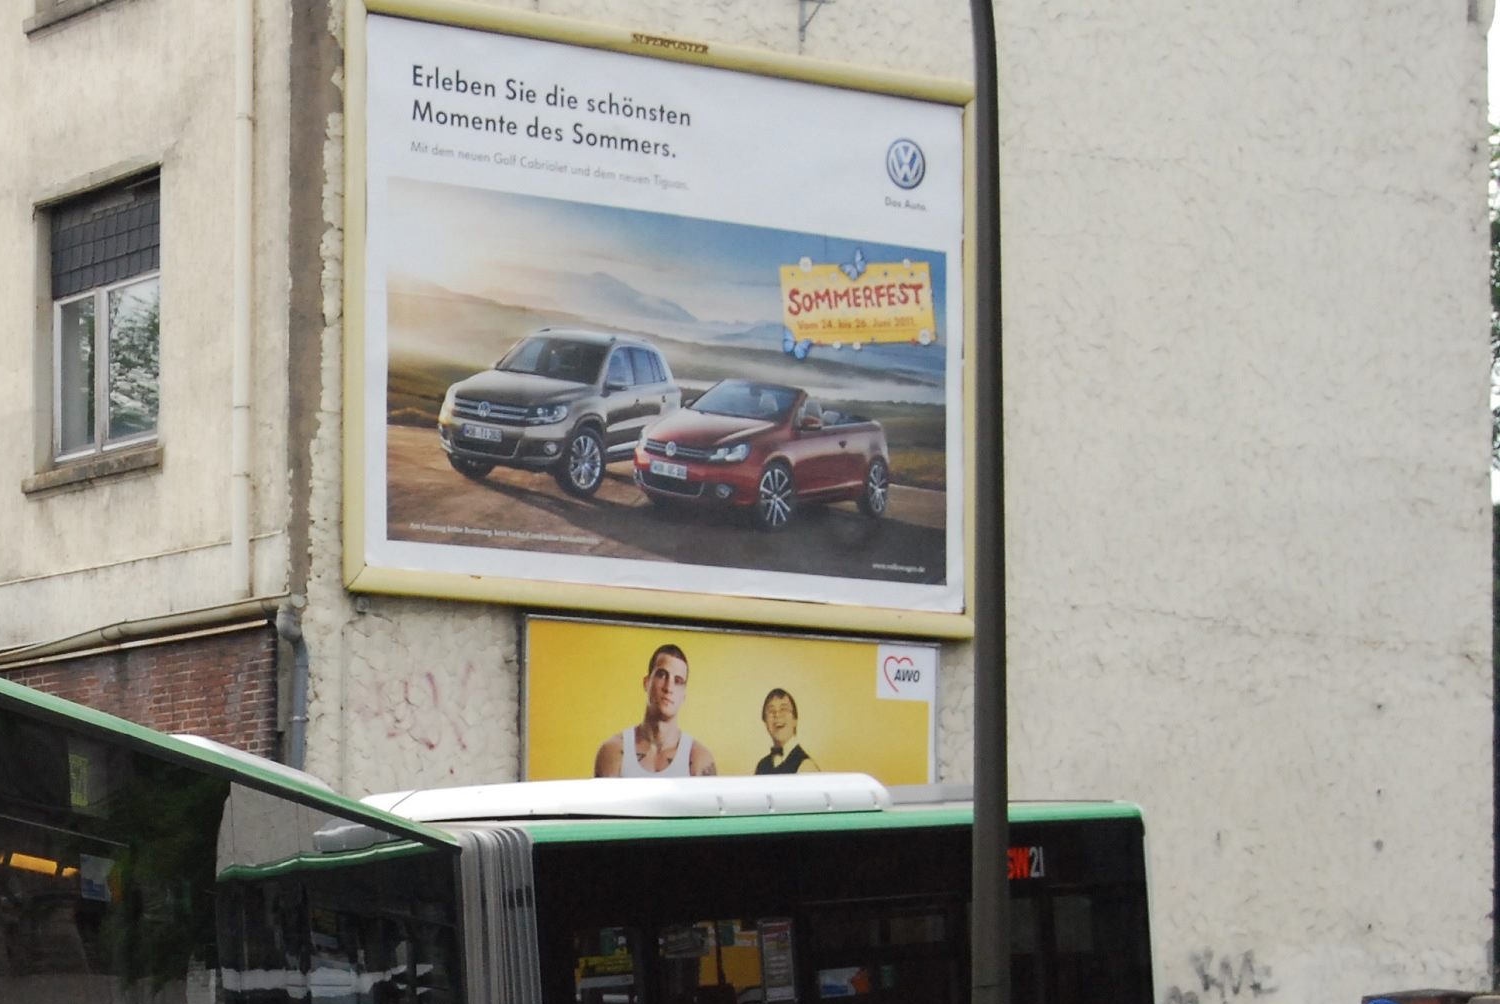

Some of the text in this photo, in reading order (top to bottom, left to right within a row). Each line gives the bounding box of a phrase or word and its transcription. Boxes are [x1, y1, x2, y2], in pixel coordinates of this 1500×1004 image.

[412, 65, 691, 127] Erleben Sie die schönsten
[412, 100, 676, 158] Momente des Sommers.
[410, 141, 428, 153] Mit
[431, 144, 454, 157] dem
[458, 149, 491, 162] neuen
[493, 152, 517, 166] Golf
[520, 156, 567, 173] Cabriolet
[571, 163, 590, 177] und
[594, 166, 616, 180] dem
[788, 283, 923, 316] SOMMERFEST
[894, 669, 920, 682] AWO
